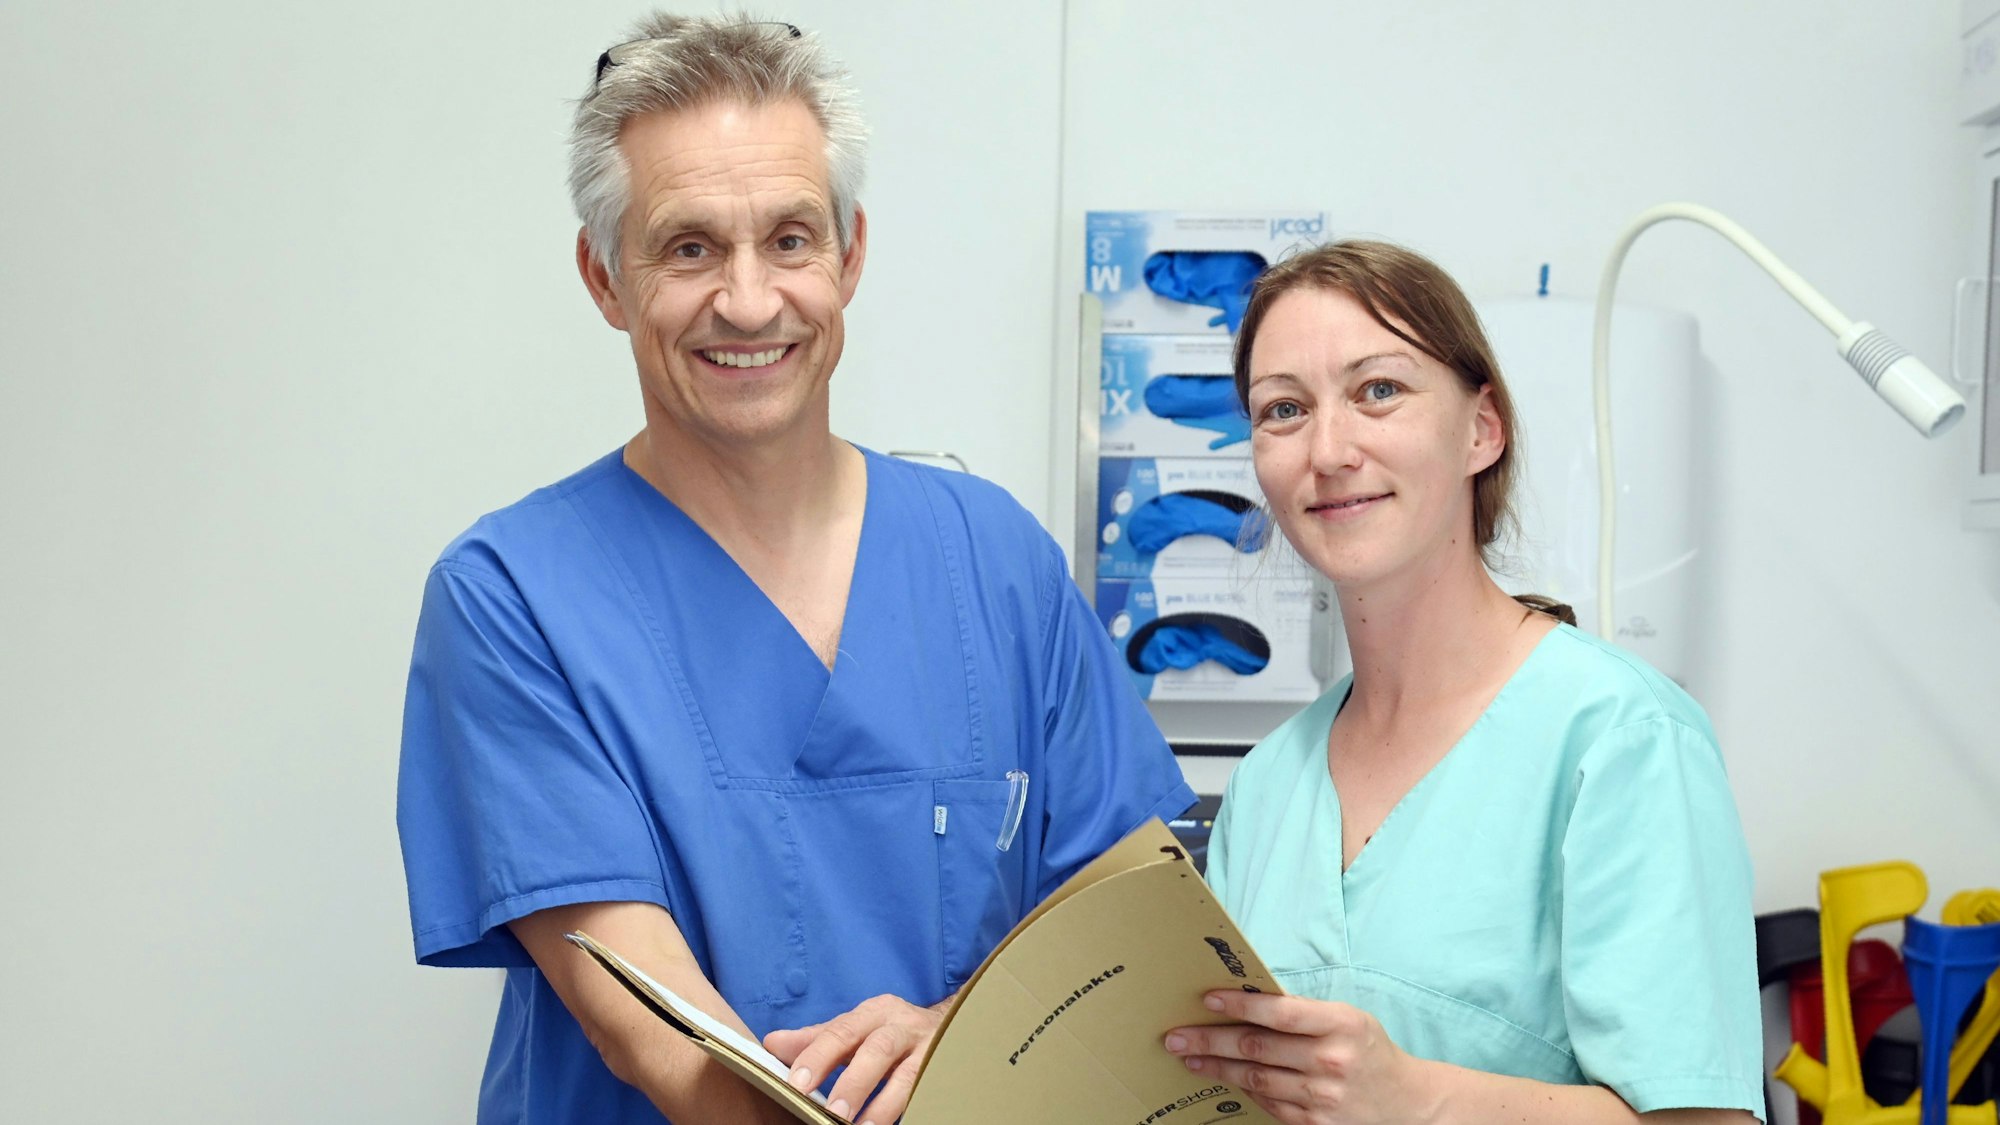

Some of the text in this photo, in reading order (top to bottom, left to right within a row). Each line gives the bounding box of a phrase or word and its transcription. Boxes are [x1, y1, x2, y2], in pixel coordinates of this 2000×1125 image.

[1091, 237, 1112, 263] 8
[1090, 265, 1121, 292] M
[1008, 964, 1125, 1066] Personalakte
